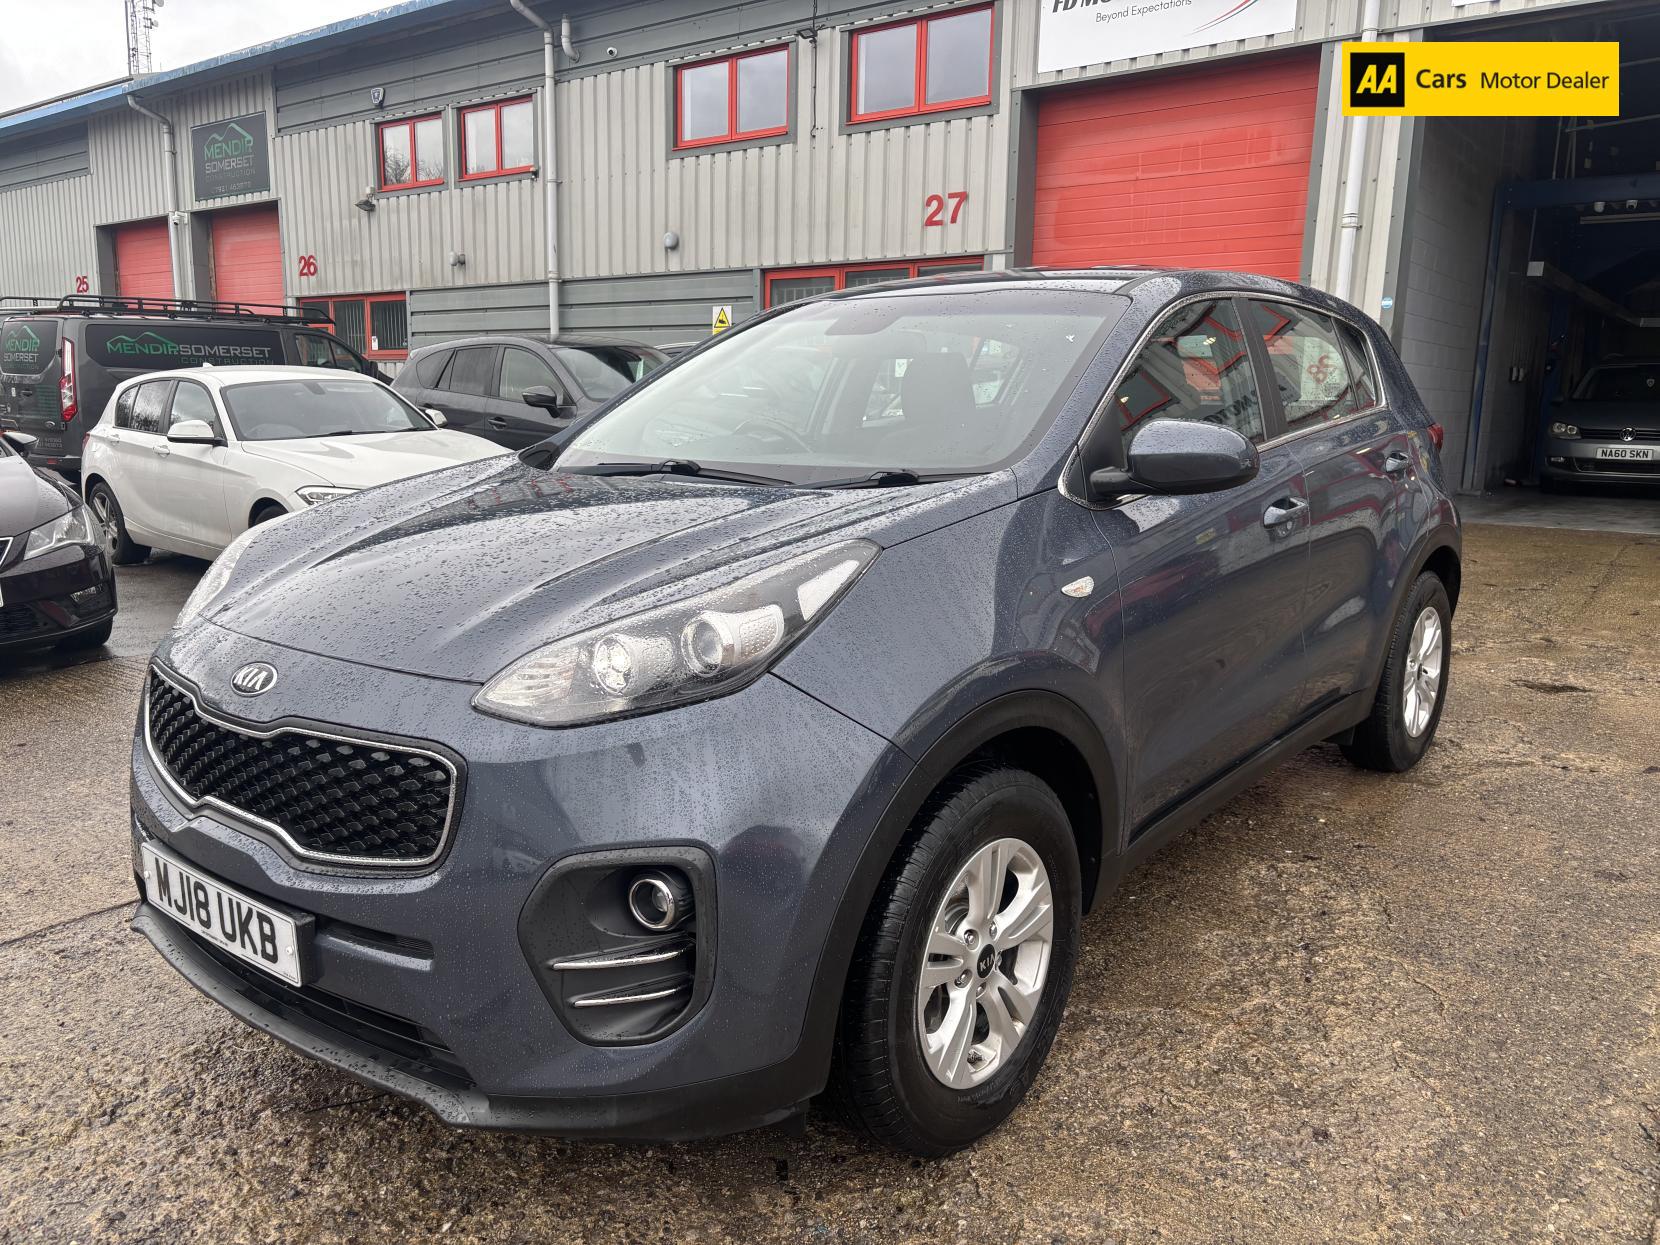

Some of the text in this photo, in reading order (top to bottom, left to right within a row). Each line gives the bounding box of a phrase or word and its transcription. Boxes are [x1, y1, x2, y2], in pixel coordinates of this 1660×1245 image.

[1095, 6, 1129, 23] Beyond
[1131, 0, 1192, 16] Expectations
[205, 154, 255, 174] SOMERSET
[924, 191, 967, 226] 27
[298, 255, 317, 276] 26
[76, 276, 89, 293] 25
[1601, 449, 1649, 459] NA60 SKN
[233, 666, 268, 690] KIA
[155, 856, 278, 964] MJ18 UKB
